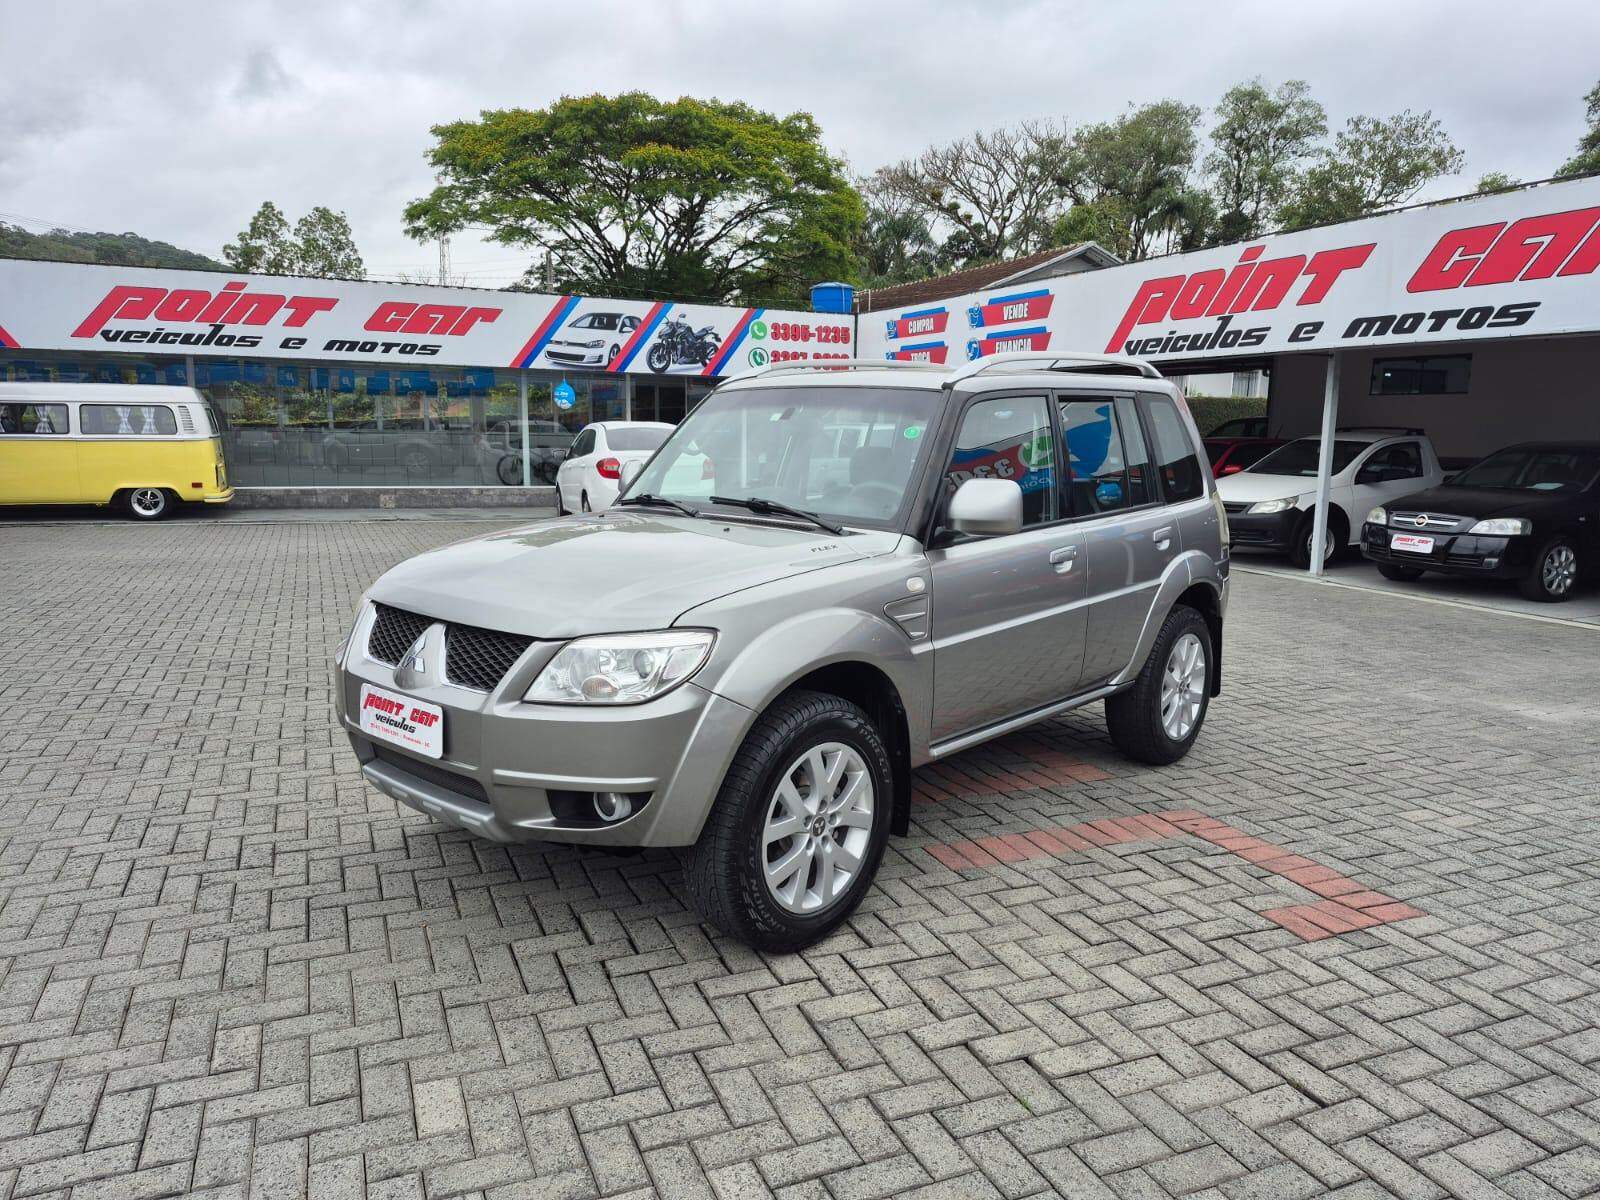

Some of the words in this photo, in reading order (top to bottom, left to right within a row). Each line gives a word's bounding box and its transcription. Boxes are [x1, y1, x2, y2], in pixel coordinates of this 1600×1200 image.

[1003, 303, 1029, 320] VENDE
[770, 322, 850, 344] 3395-1235
[908, 318, 934, 334] COMPRA
